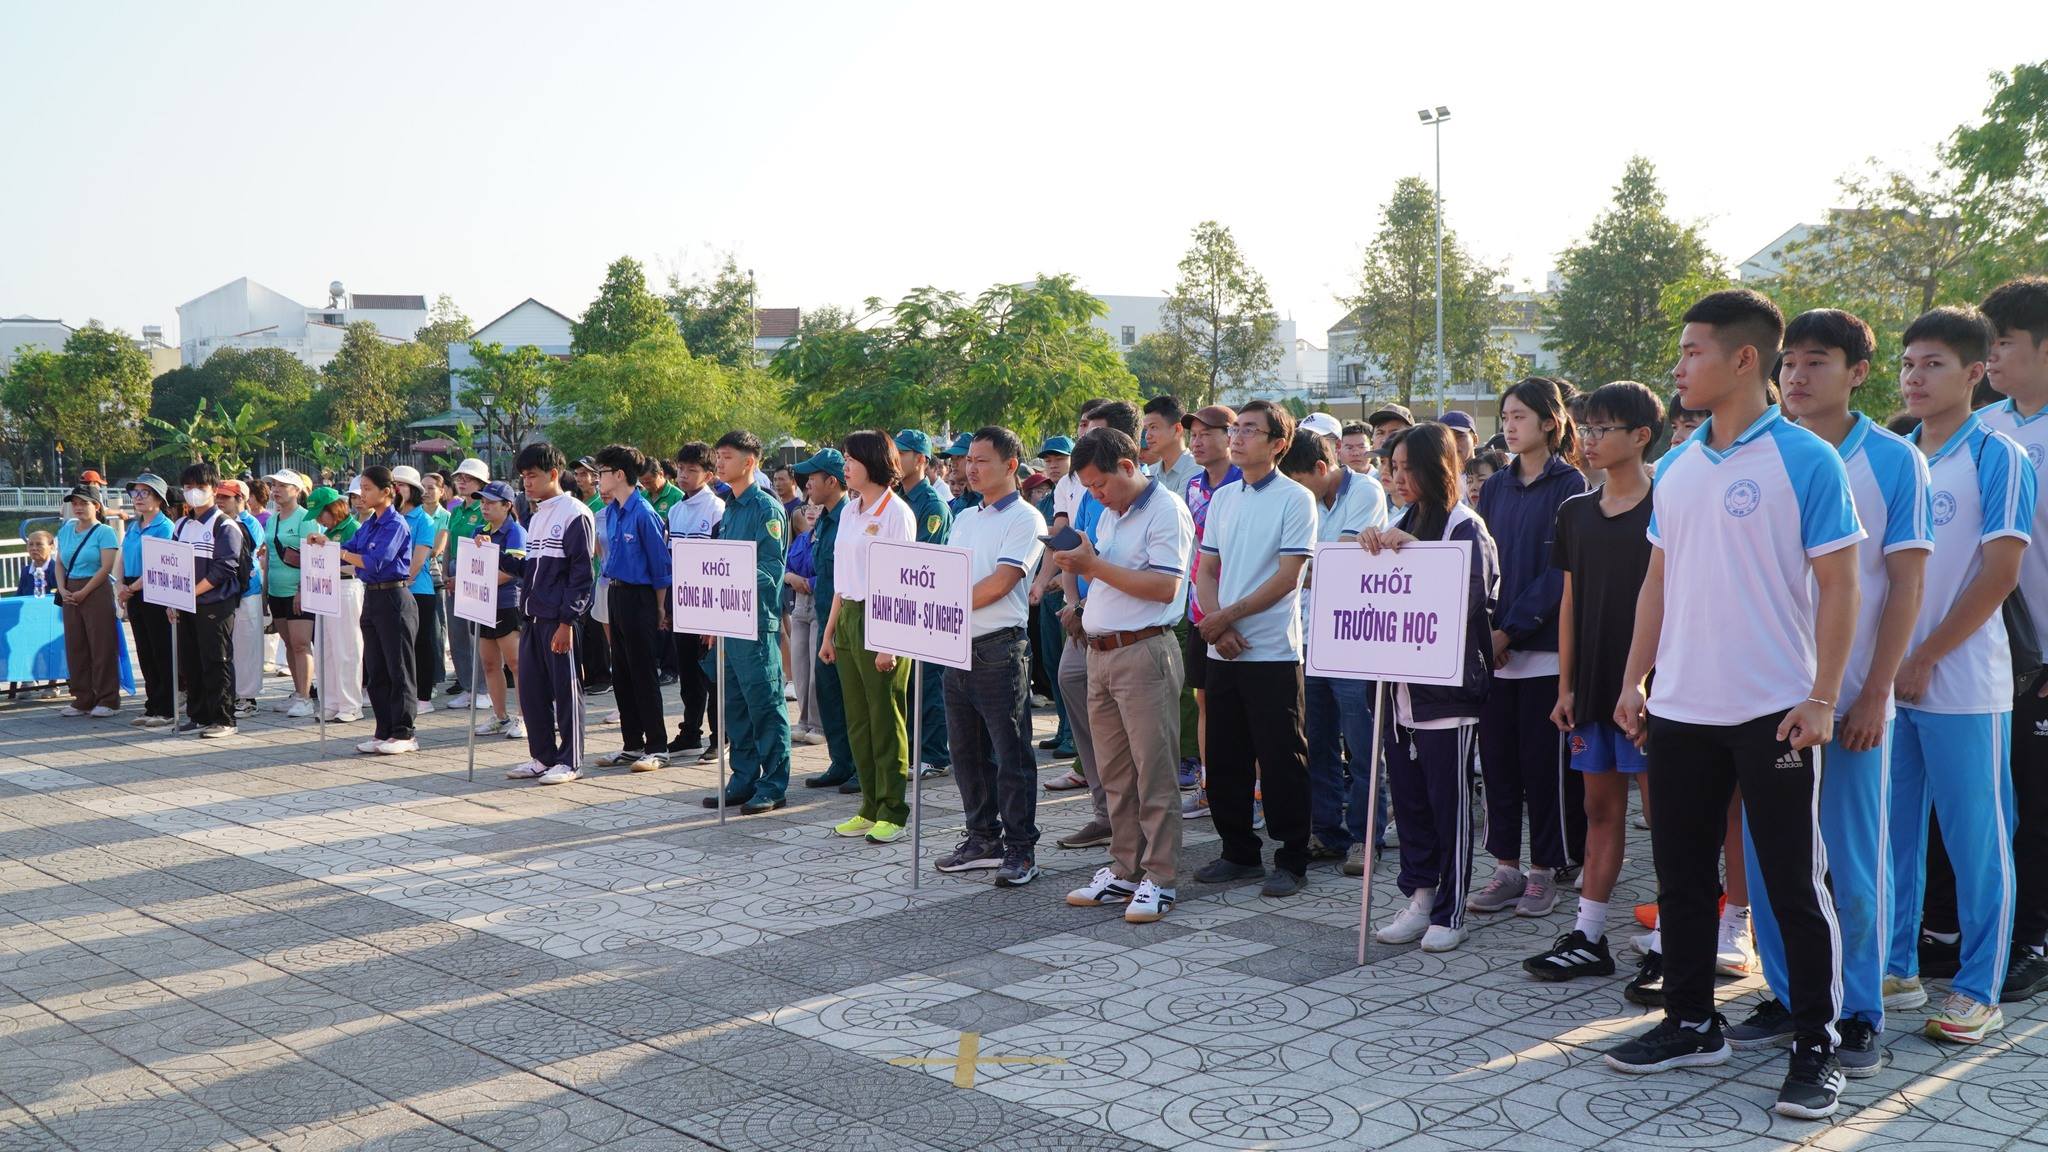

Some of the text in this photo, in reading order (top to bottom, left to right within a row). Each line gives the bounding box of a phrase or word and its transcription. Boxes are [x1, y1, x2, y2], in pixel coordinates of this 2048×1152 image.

[160, 552, 179, 568] KHỐI
[702, 557, 730, 577] KHỐI
[900, 564, 936, 589] KHỐI
[1360, 567, 1413, 595] KHỐI
[677, 581, 700, 608] CÔNG
[702, 587, 713, 608] AN
[720, 584, 740, 612] QUÂN
[742, 588, 752, 618] SỰ
[872, 589, 892, 622] HÀNH
[894, 593, 917, 627] CHÍNH
[923, 601, 935, 636] SỰ
[935, 601, 964, 641] NGHIỆP
[1333, 602, 1438, 651] TRƯỜNG HỌC
[1775, 761, 1803, 769] adidas
